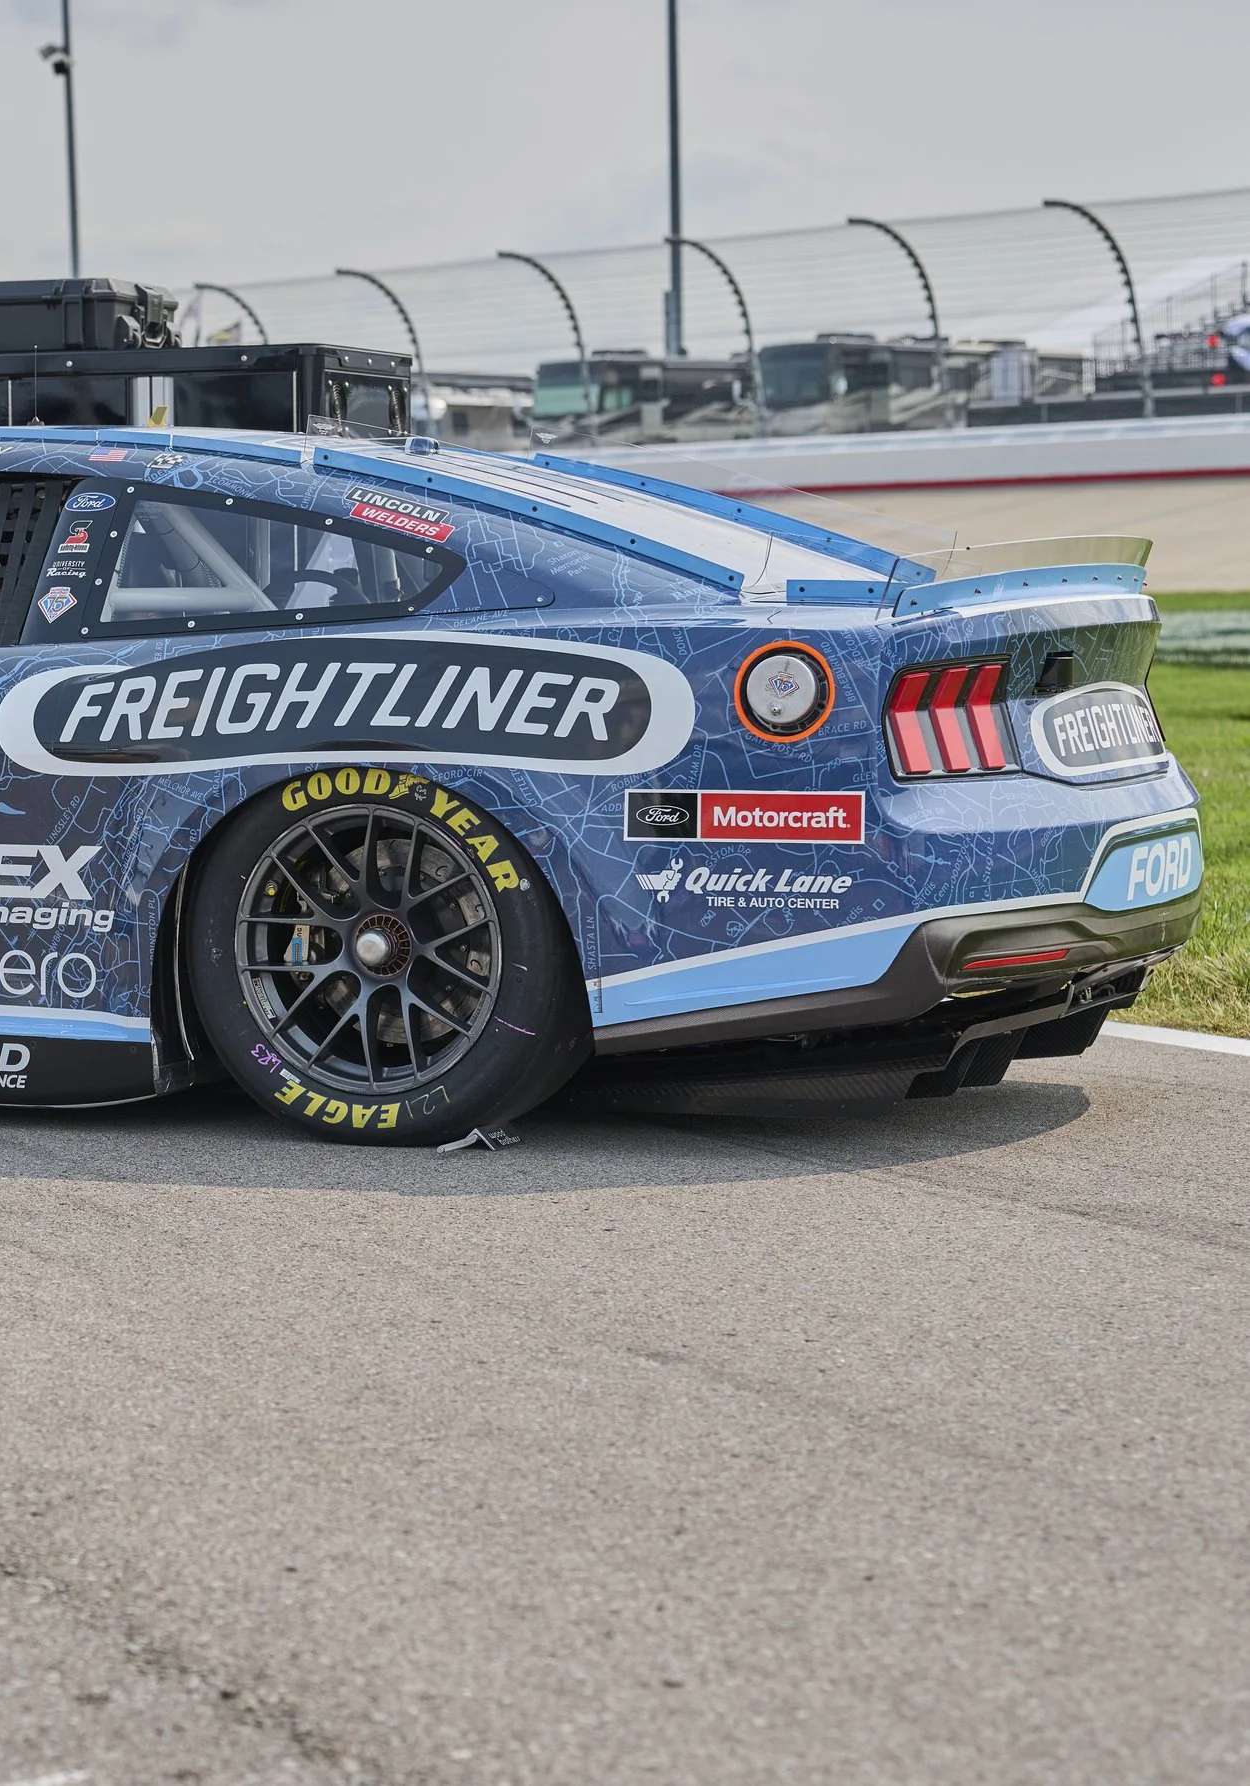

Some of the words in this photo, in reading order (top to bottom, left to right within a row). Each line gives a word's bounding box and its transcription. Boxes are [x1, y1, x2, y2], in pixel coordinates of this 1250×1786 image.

[72, 493, 106, 509] Ford
[351, 489, 441, 522] LINCOLN
[361, 506, 440, 537] WELDERS
[547, 549, 581, 566] Sharon
[550, 553, 592, 576] Memorial
[46, 567, 87, 579] Racing
[567, 563, 590, 577] Park
[831, 652, 857, 702] BRAEBURN
[59, 661, 621, 743] FREIGHTLINER
[818, 722, 850, 736] BRACE
[853, 719, 867, 730] RD
[1053, 703, 1161, 757] FREIGHTLINER
[693, 743, 703, 758] DR
[772, 741, 798, 757] POST
[798, 751, 813, 764] RD
[466, 768, 484, 778] CIR
[853, 771, 878, 784] GLEN
[157, 776, 191, 796] MELCHOR
[191, 789, 205, 801] AVE
[70, 795, 81, 809] RD
[643, 806, 682, 825] Ford
[713, 806, 847, 828] Motorcraft
[737, 843, 752, 856] DR
[1126, 834, 1192, 901] FORD
[685, 866, 774, 895] Quick
[774, 867, 853, 895] Lane
[706, 896, 736, 908] TIRE
[738, 897, 748, 908] &
[749, 897, 786, 909] AUTO
[787, 897, 840, 910] CENTER
[933, 882, 950, 903] Cem
[586, 916, 595, 928] LN
[586, 931, 596, 970] SHASTA
[273, 1079, 400, 1129] EAGLE
